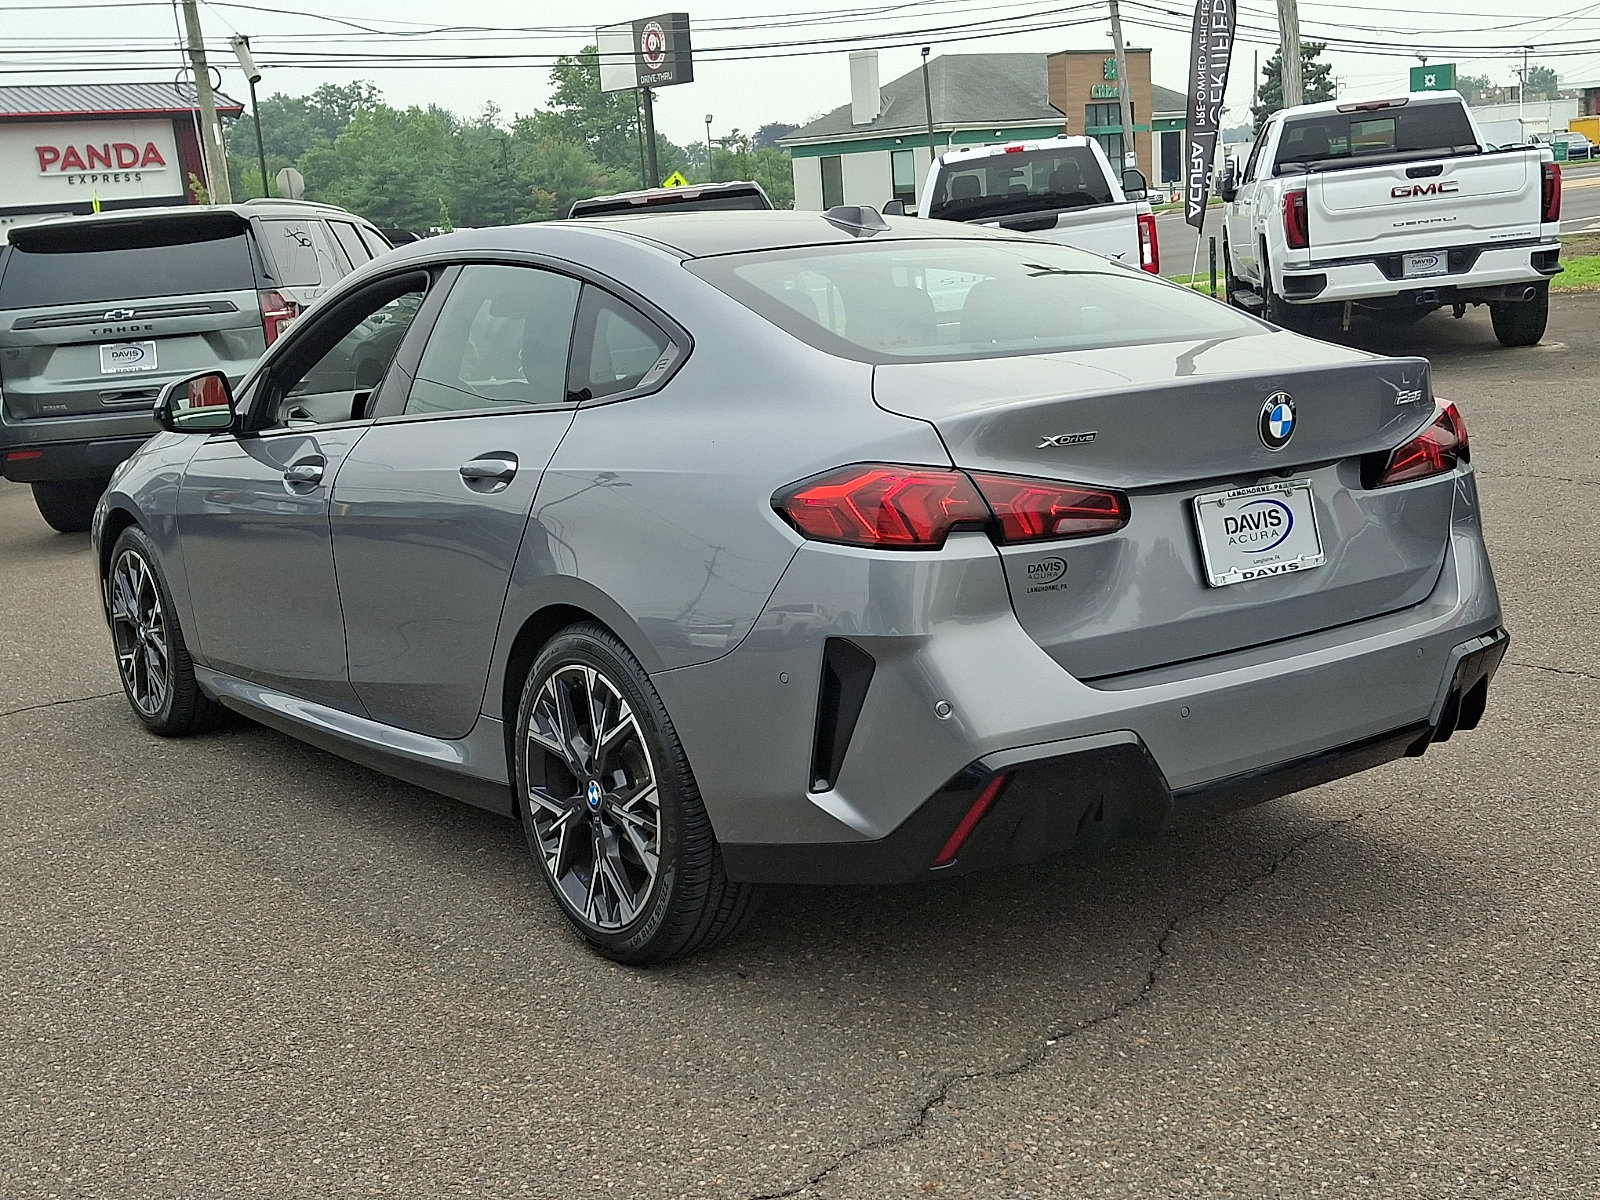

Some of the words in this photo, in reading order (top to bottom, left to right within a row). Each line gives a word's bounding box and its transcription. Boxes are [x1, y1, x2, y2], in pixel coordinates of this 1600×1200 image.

[641, 71, 673, 84] DRIVE-THRU
[35, 142, 167, 172] PANDA
[68, 172, 142, 185] EXPRESS
[1391, 180, 1459, 198] GMC
[1392, 216, 1457, 228] DENALI
[89, 324, 153, 335] TAHOE
[111, 350, 139, 359] DAVIS
[1223, 508, 1282, 535] DAVIS
[1228, 529, 1280, 546] ACURA
[1028, 561, 1061, 574] DAVIS
[1242, 562, 1300, 580] DAVIS
[1028, 571, 1059, 580] ACURA
